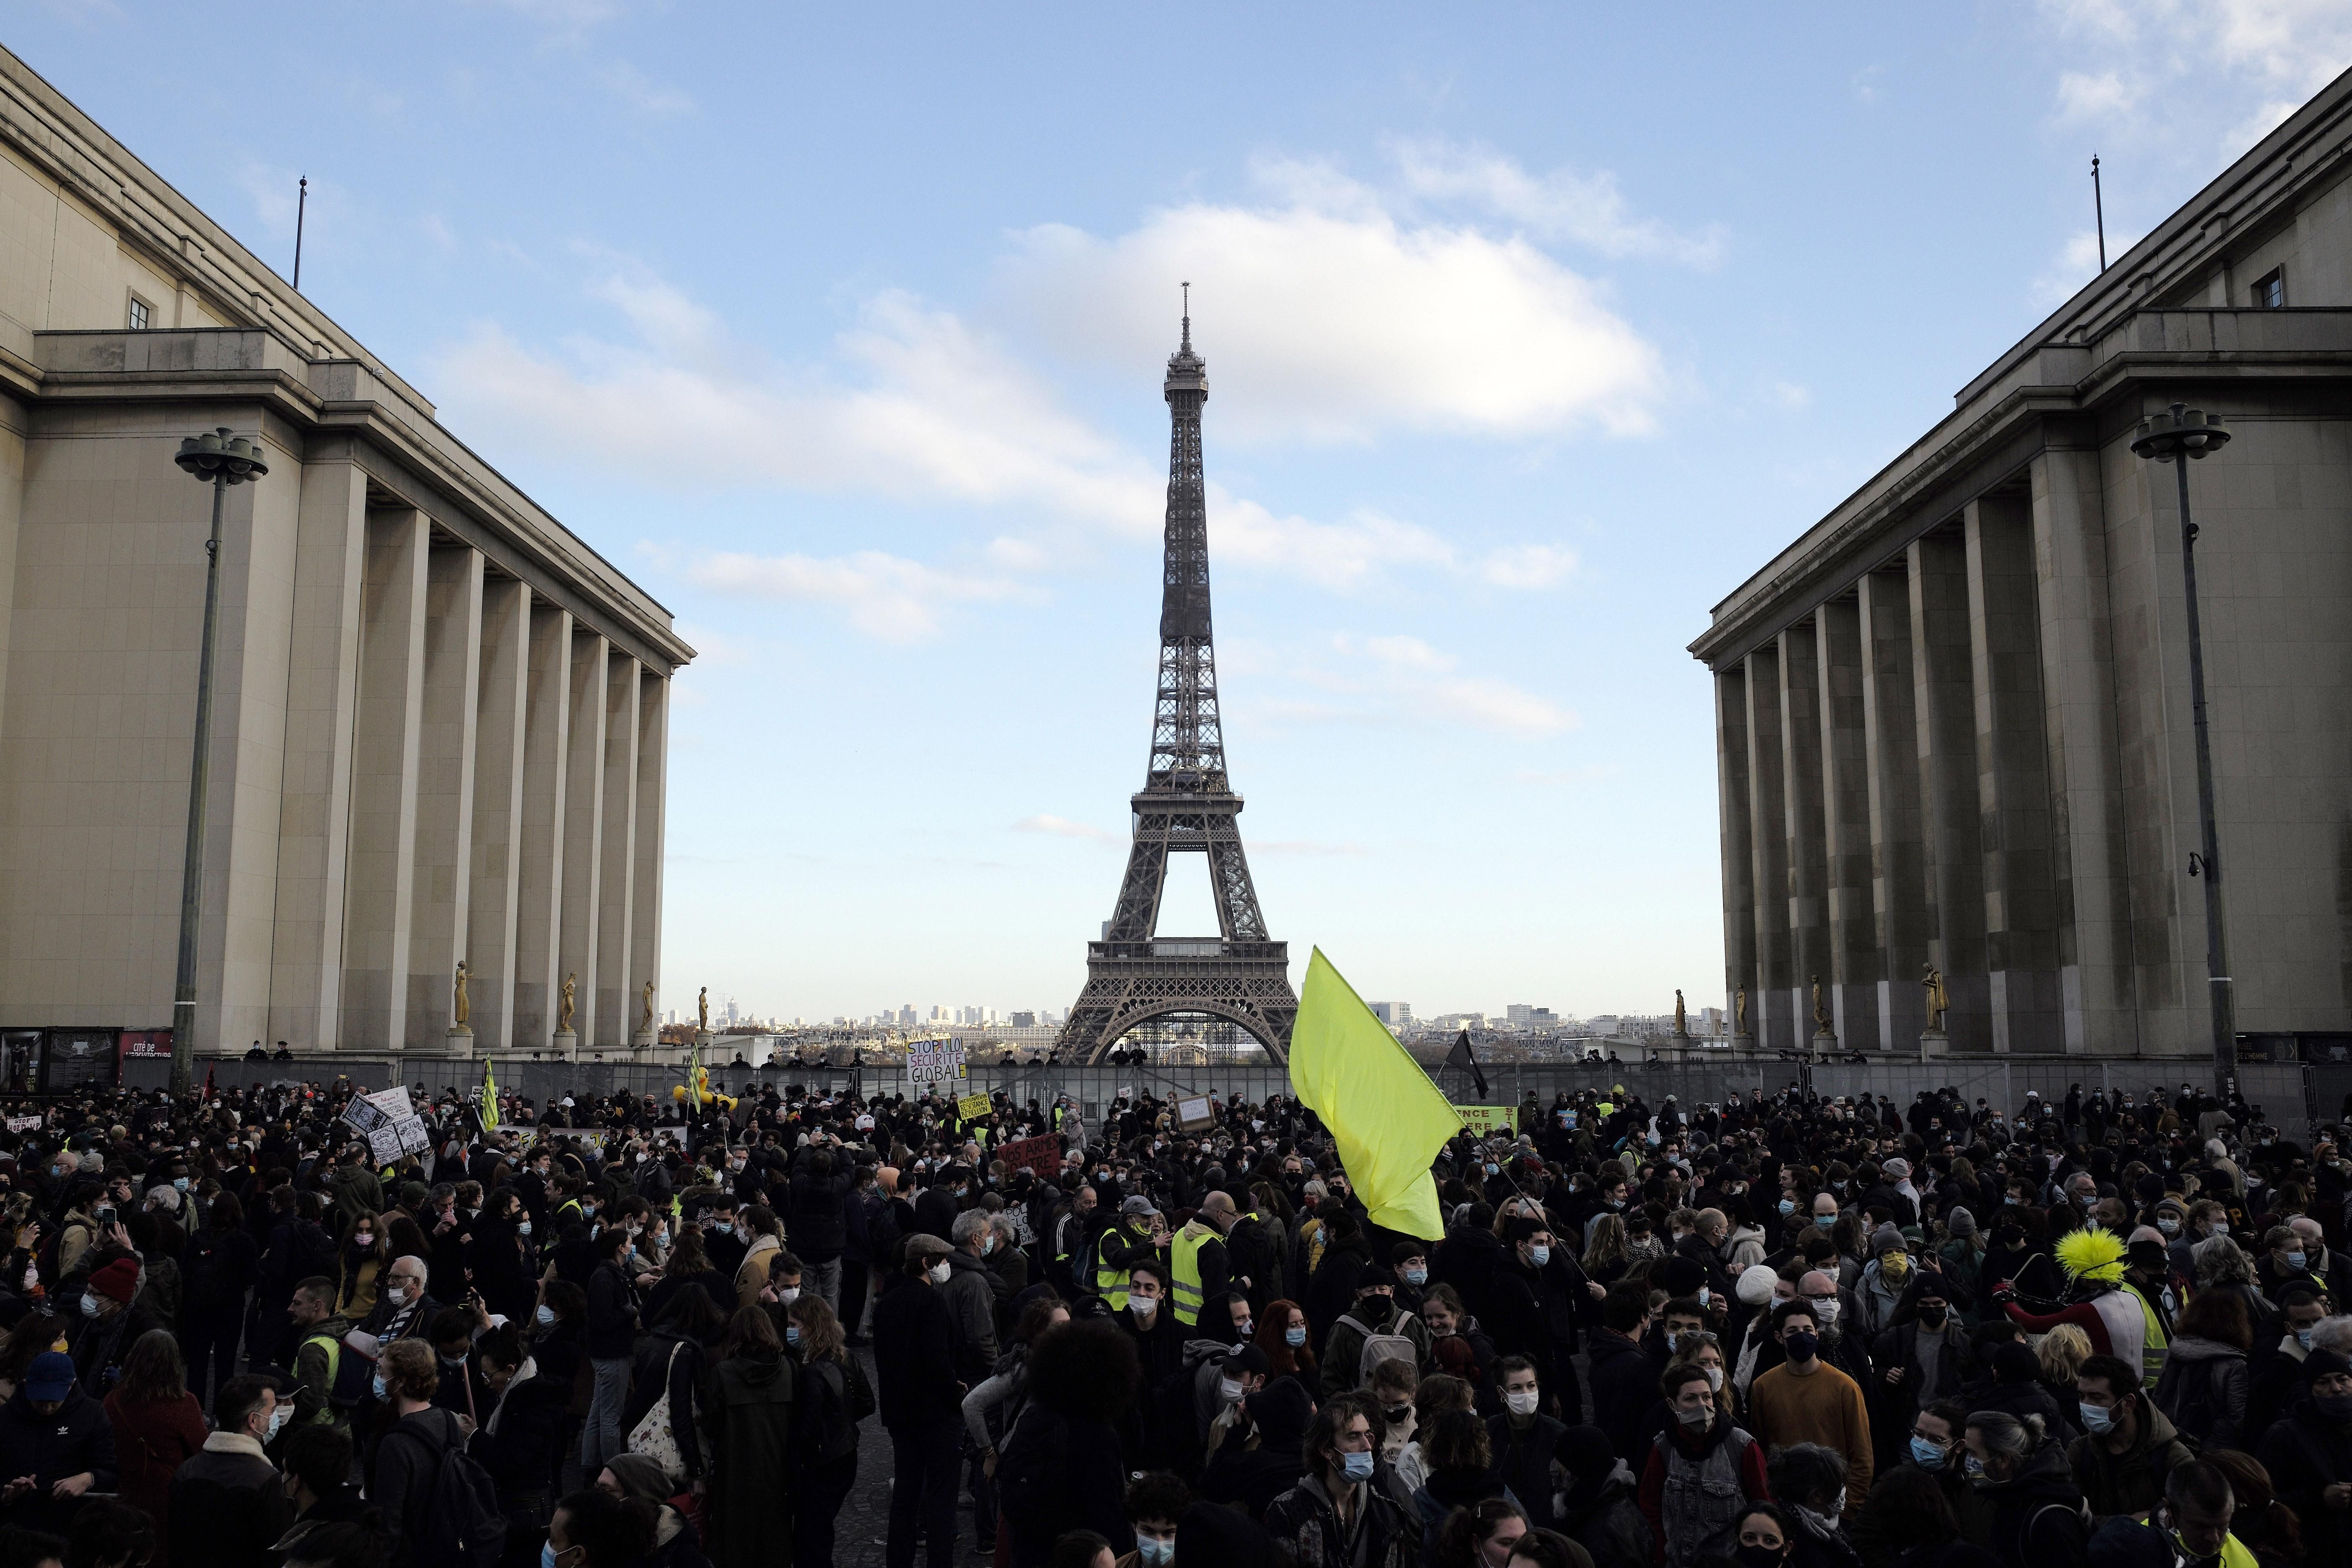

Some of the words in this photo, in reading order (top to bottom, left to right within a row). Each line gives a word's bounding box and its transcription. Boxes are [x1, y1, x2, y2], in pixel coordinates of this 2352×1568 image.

[908, 1040, 939, 1054] STOP
[950, 1038, 963, 1052] LOI
[911, 1051, 962, 1068] SÉCURITÉ
[912, 1064, 966, 1082] GLOBALE
[1010, 1154, 1053, 1176] ONTRE
